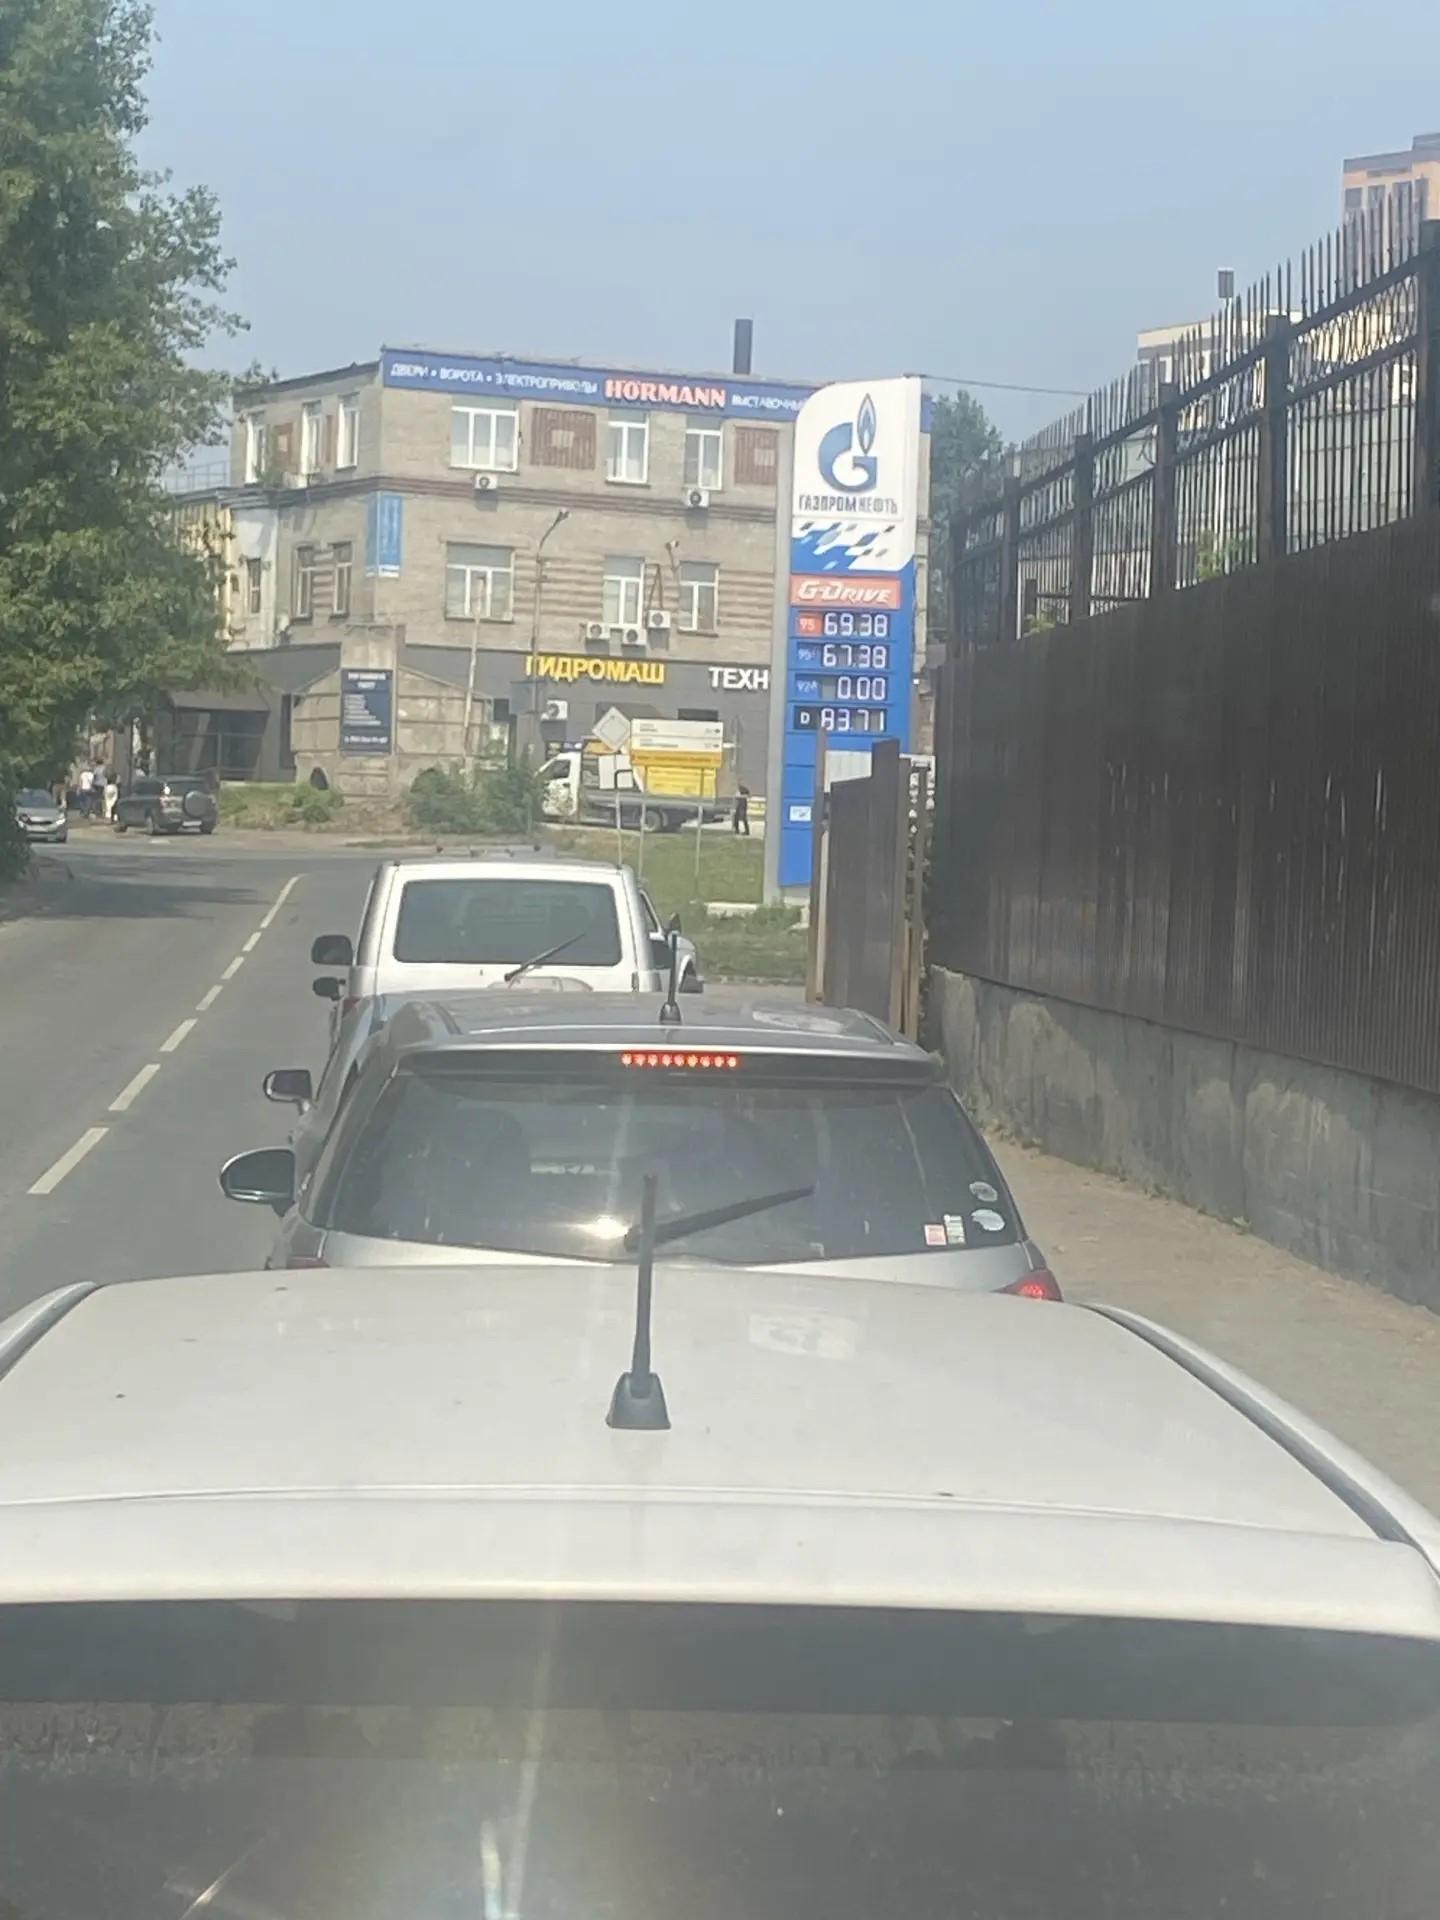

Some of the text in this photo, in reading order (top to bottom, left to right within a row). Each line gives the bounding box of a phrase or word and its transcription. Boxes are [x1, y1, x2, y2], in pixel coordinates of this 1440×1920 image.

[440, 367, 483, 382] ВОРОТА
[824, 612, 888, 636] 69.38
[823, 644, 887, 669] 67.38
[837, 676, 886, 700] 0.00
[821, 708, 885, 732] 83.71
